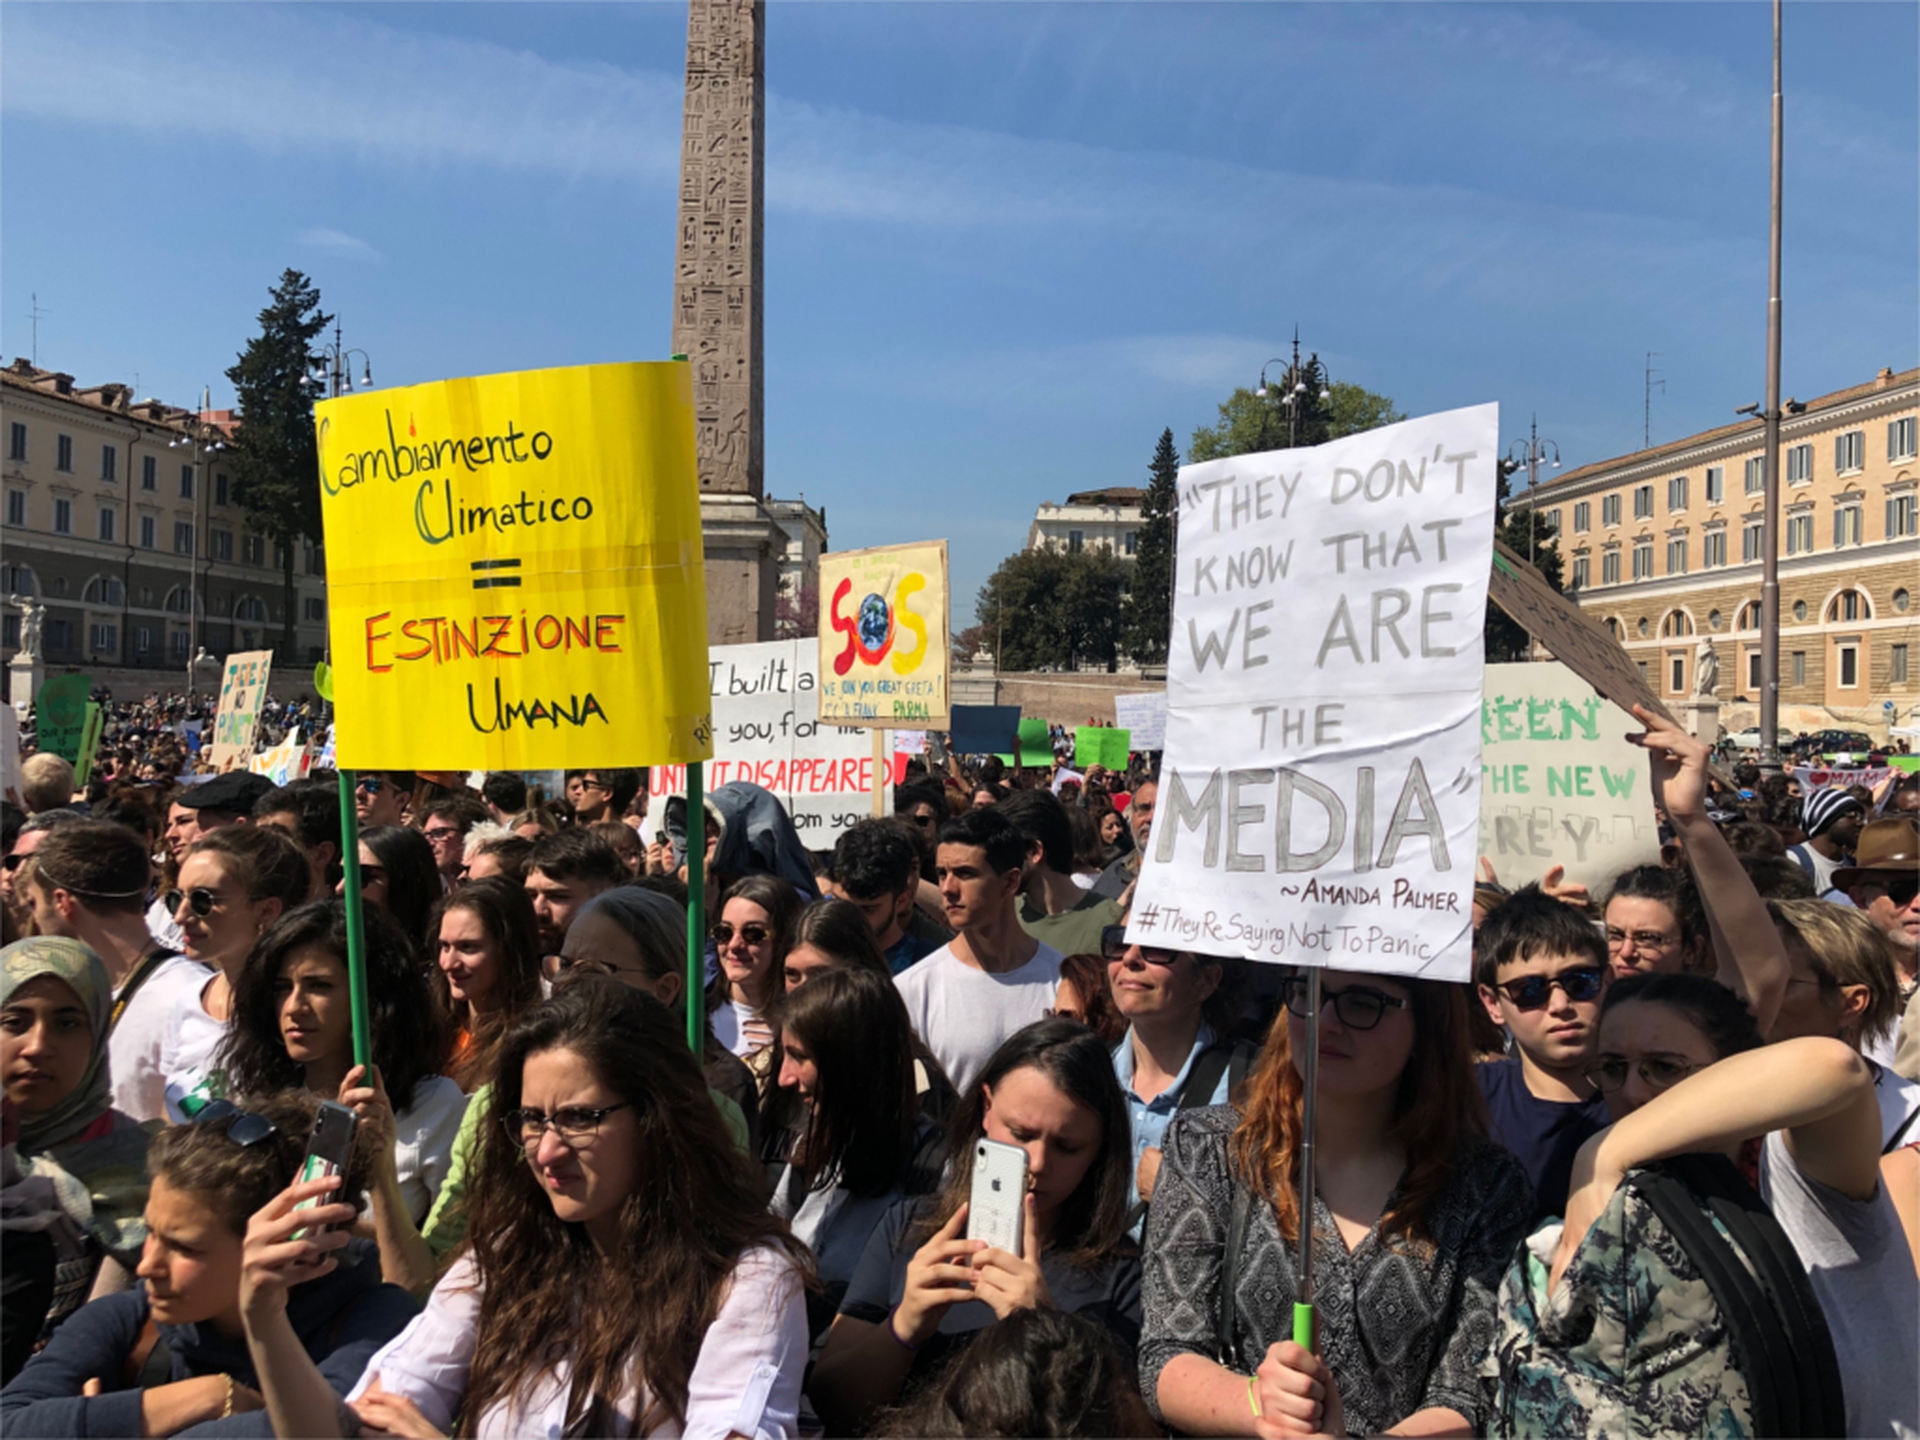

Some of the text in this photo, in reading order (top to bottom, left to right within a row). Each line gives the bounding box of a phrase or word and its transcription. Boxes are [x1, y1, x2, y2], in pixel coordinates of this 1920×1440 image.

[318, 408, 553, 497] Cambiamento
[1330, 443, 1477, 506] DON'T
[414, 479, 593, 545] Climatico
[1193, 517, 1463, 597] KNOW THAT
[830, 572, 928, 677] SOS
[1187, 599, 1275, 674] WE
[1313, 582, 1464, 670] ARE
[466, 677, 608, 733] UMANA
[728, 658, 788, 696] built
[797, 671, 815, 692] a
[877, 680, 902, 695] GREAT
[893, 700, 931, 723] PARMA
[1251, 702, 1346, 750] THE
[1546, 764, 1637, 801] NEW
[1392, 877, 1461, 915] PALMER
